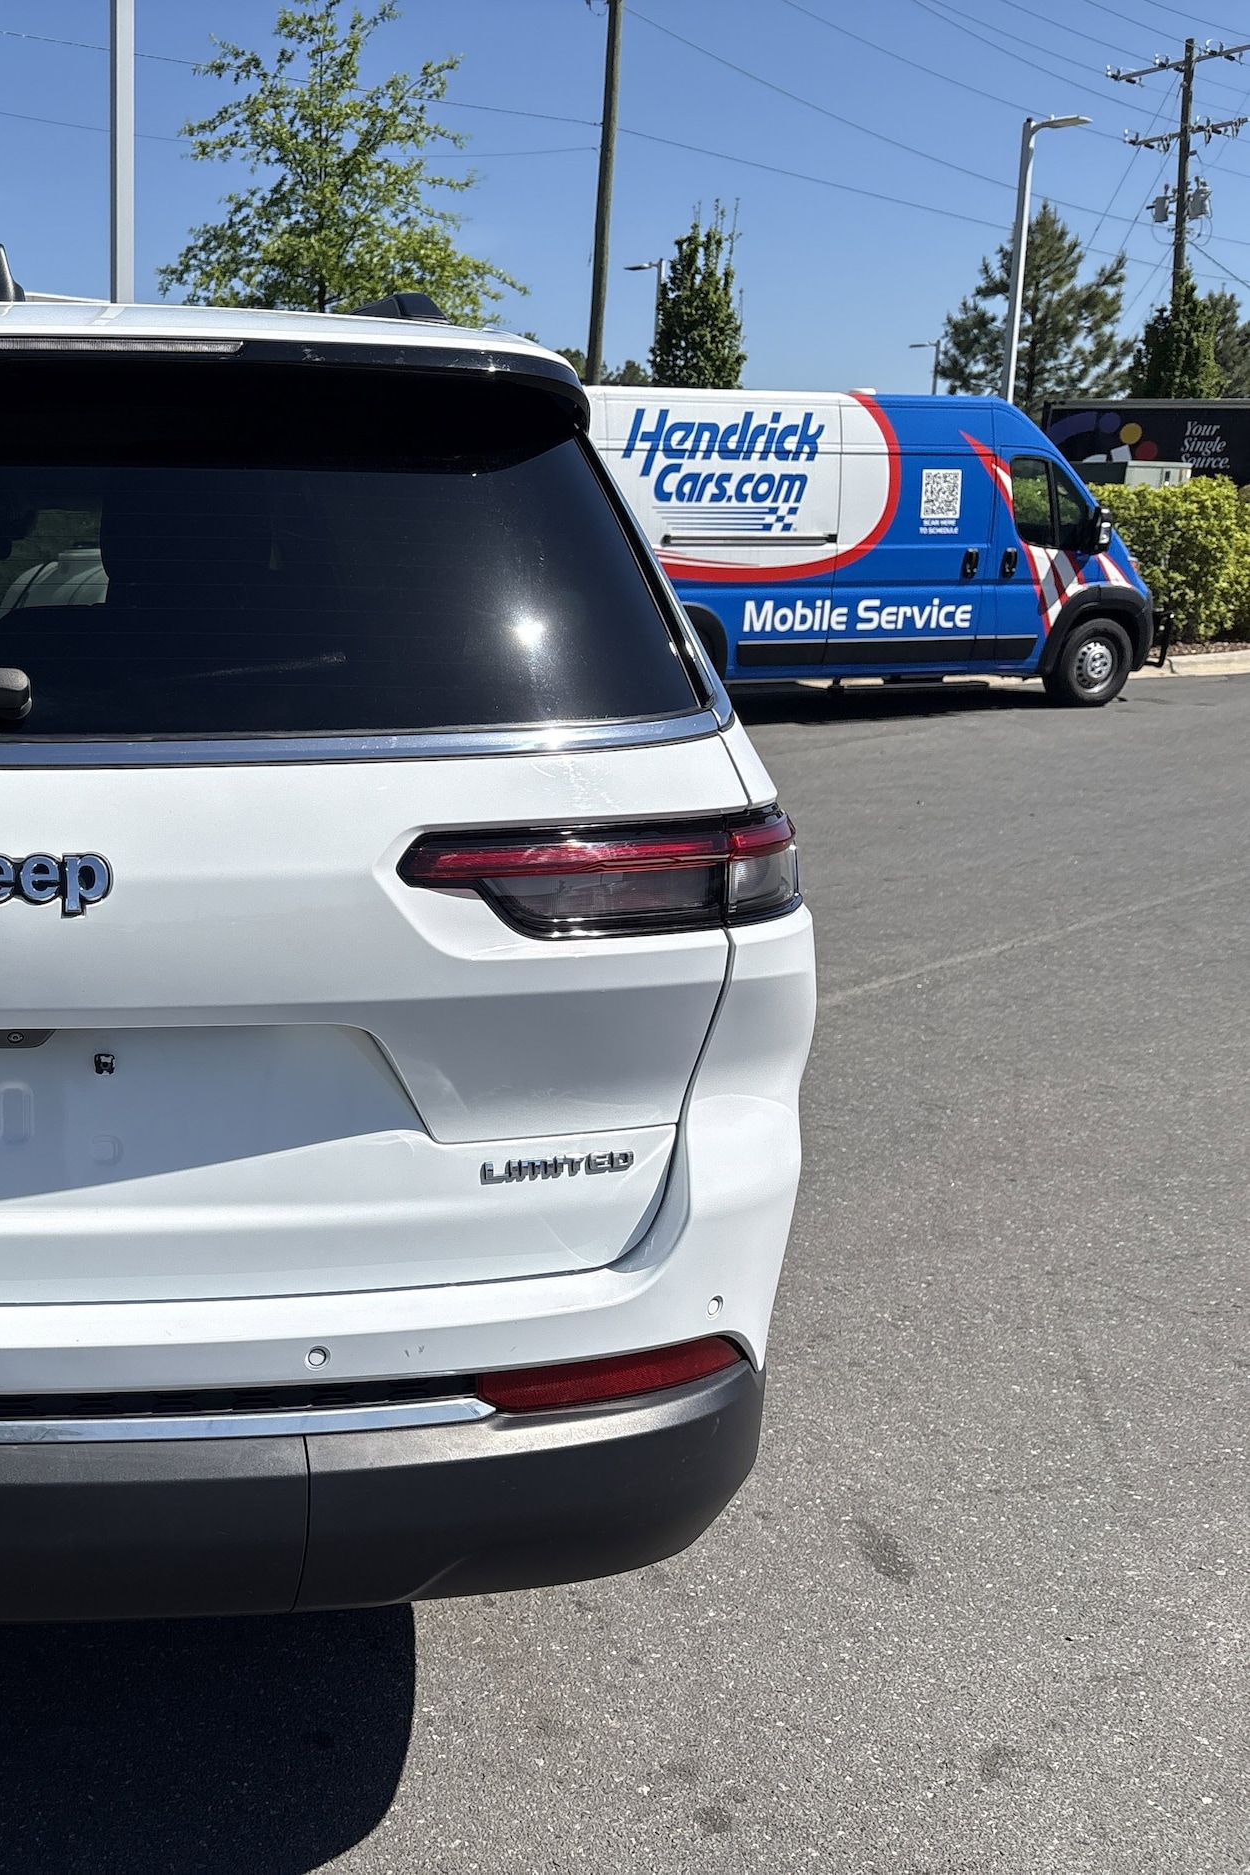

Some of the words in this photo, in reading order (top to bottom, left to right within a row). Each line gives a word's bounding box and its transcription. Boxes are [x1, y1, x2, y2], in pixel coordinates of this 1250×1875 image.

[621, 408, 825, 477] Hendrick
[1180, 436, 1227, 456] Single
[1185, 420, 1221, 436] Your
[654, 463, 808, 504] Cars.com
[742, 599, 849, 633] Mobile
[855, 597, 973, 631] Service
[480, 1149, 635, 1186] LIMITED
